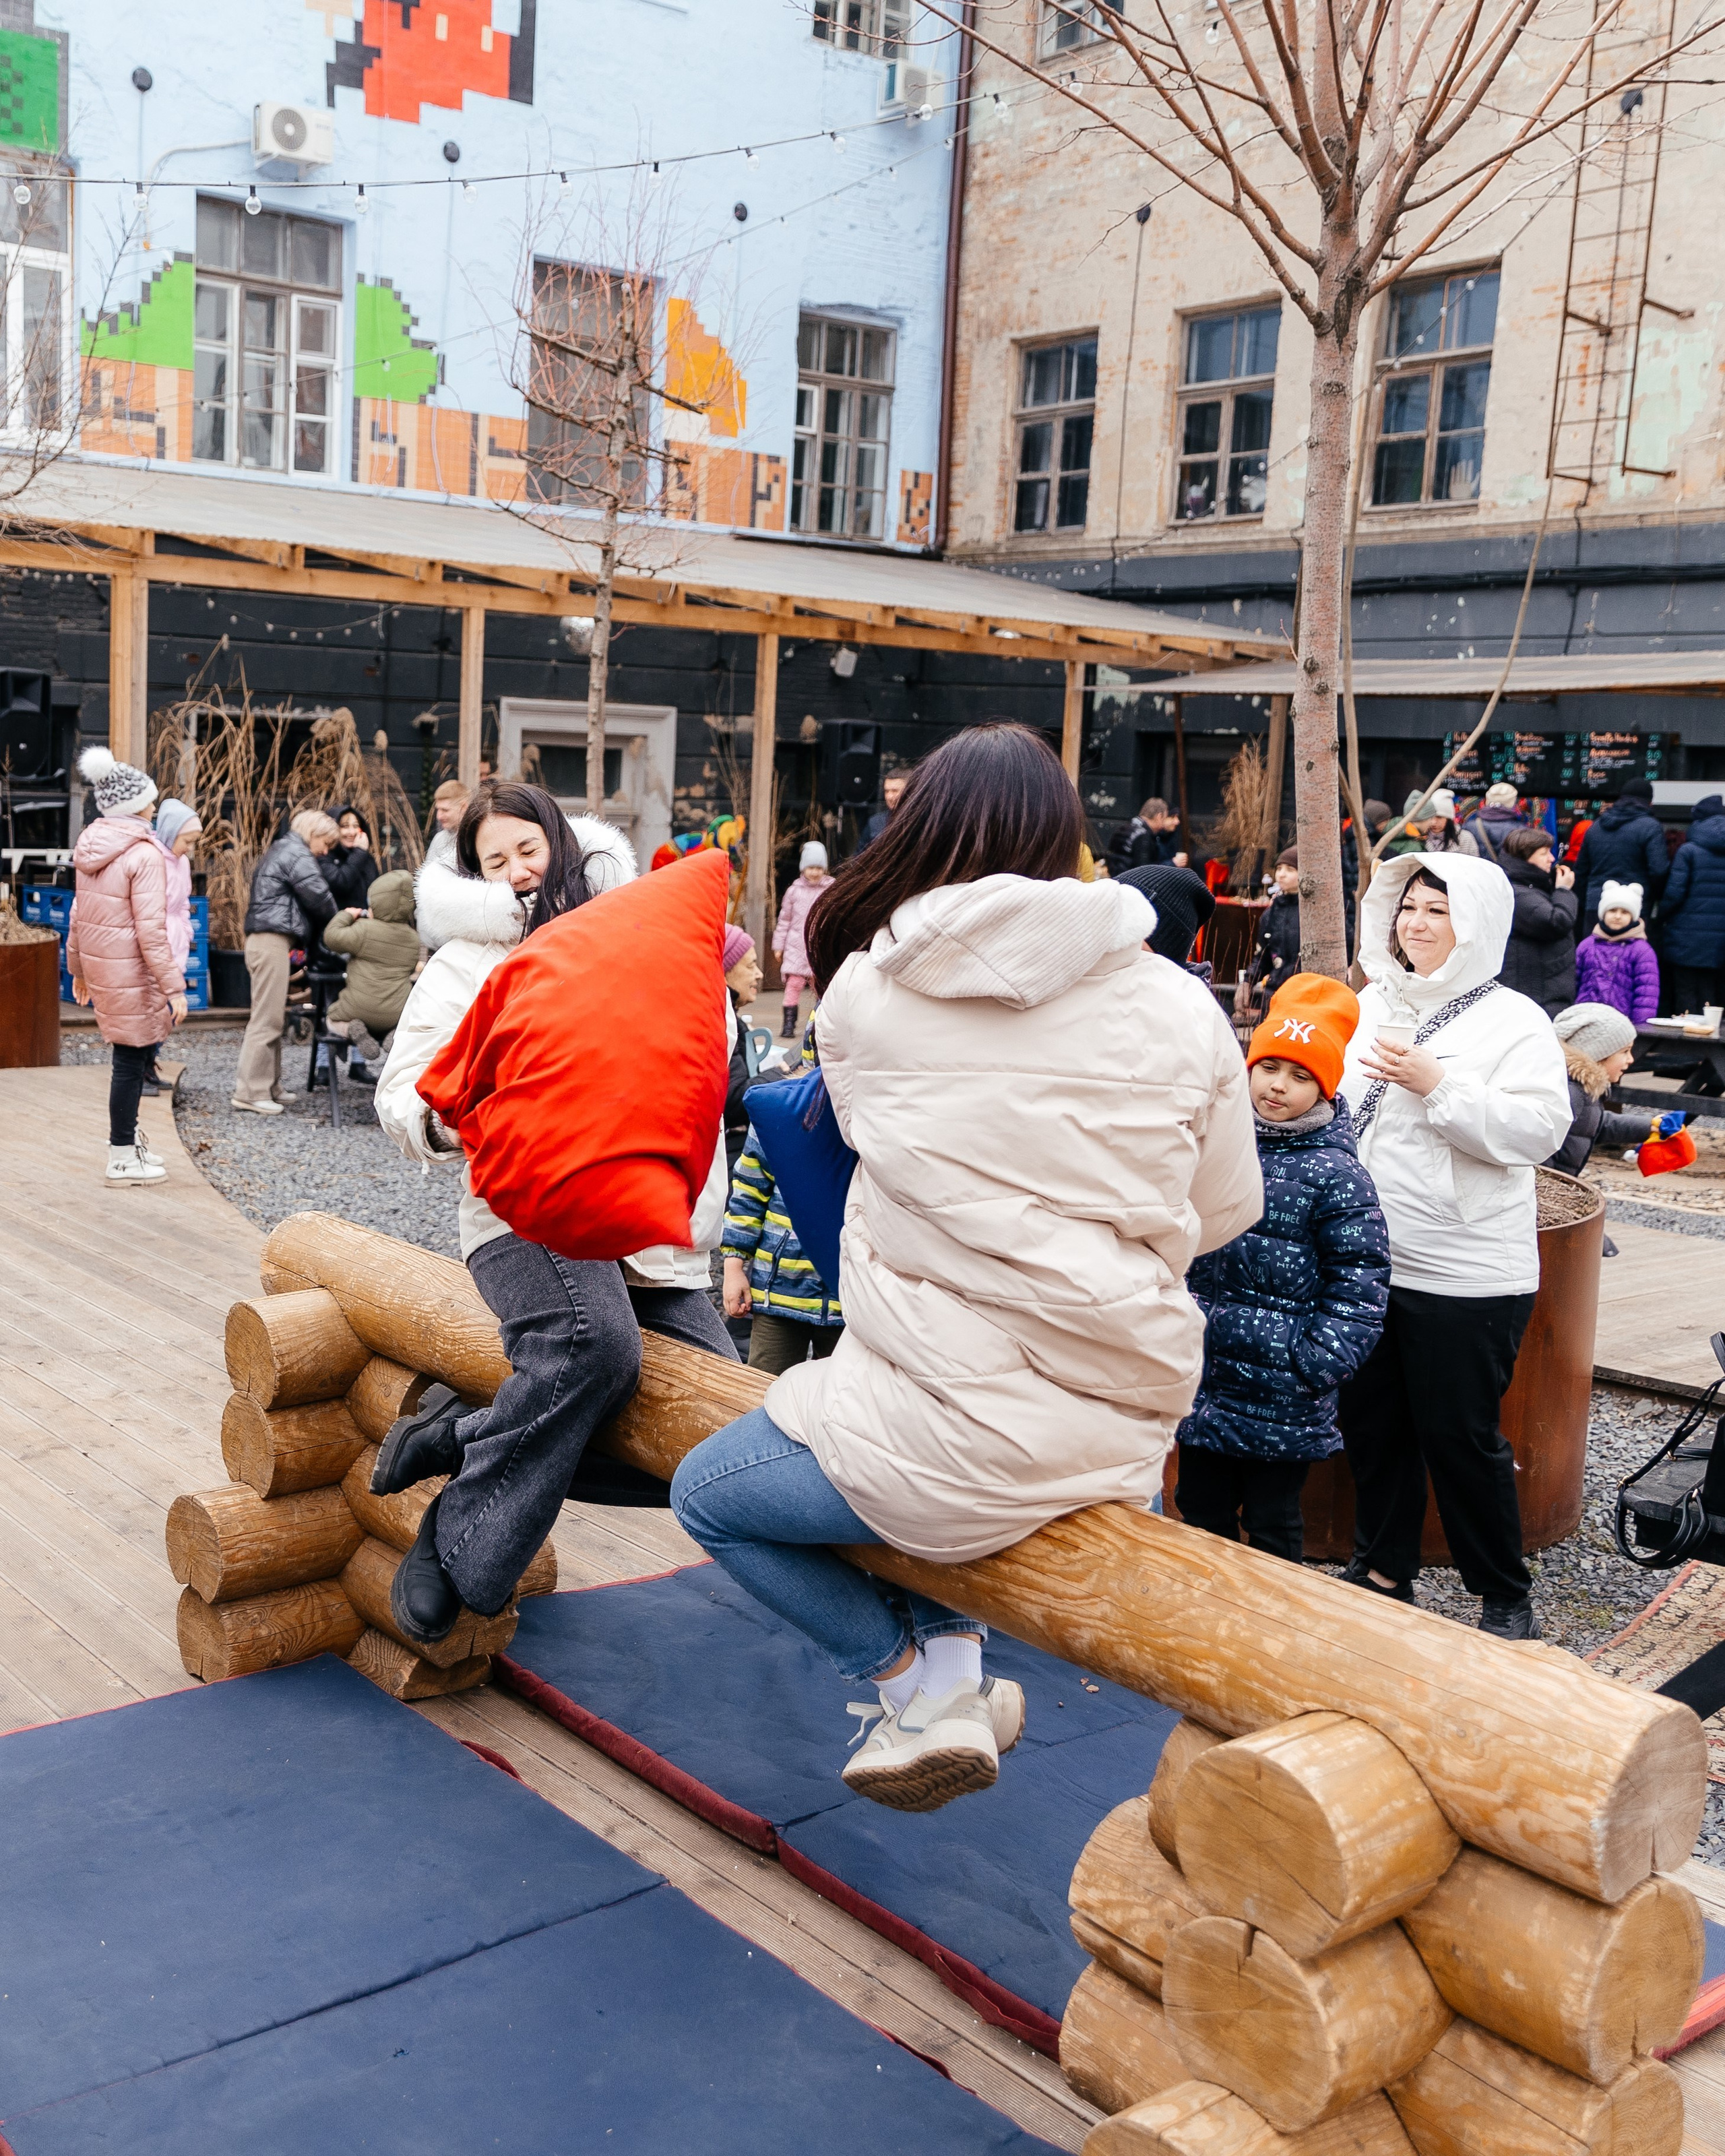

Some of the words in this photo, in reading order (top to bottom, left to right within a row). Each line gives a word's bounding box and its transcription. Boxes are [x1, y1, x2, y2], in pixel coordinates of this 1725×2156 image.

[1274, 1018, 1316, 1044] NY
[1269, 1210, 1279, 1219] BE
[1280, 1213, 1300, 1224] FREE
[1341, 1225, 1362, 1236] CRAZY
[1332, 1303, 1354, 1313] CRAZY
[1272, 1393, 1292, 1405] CRAZY
[1247, 1405, 1256, 1414] BE
[1257, 1407, 1277, 1419] FREE
